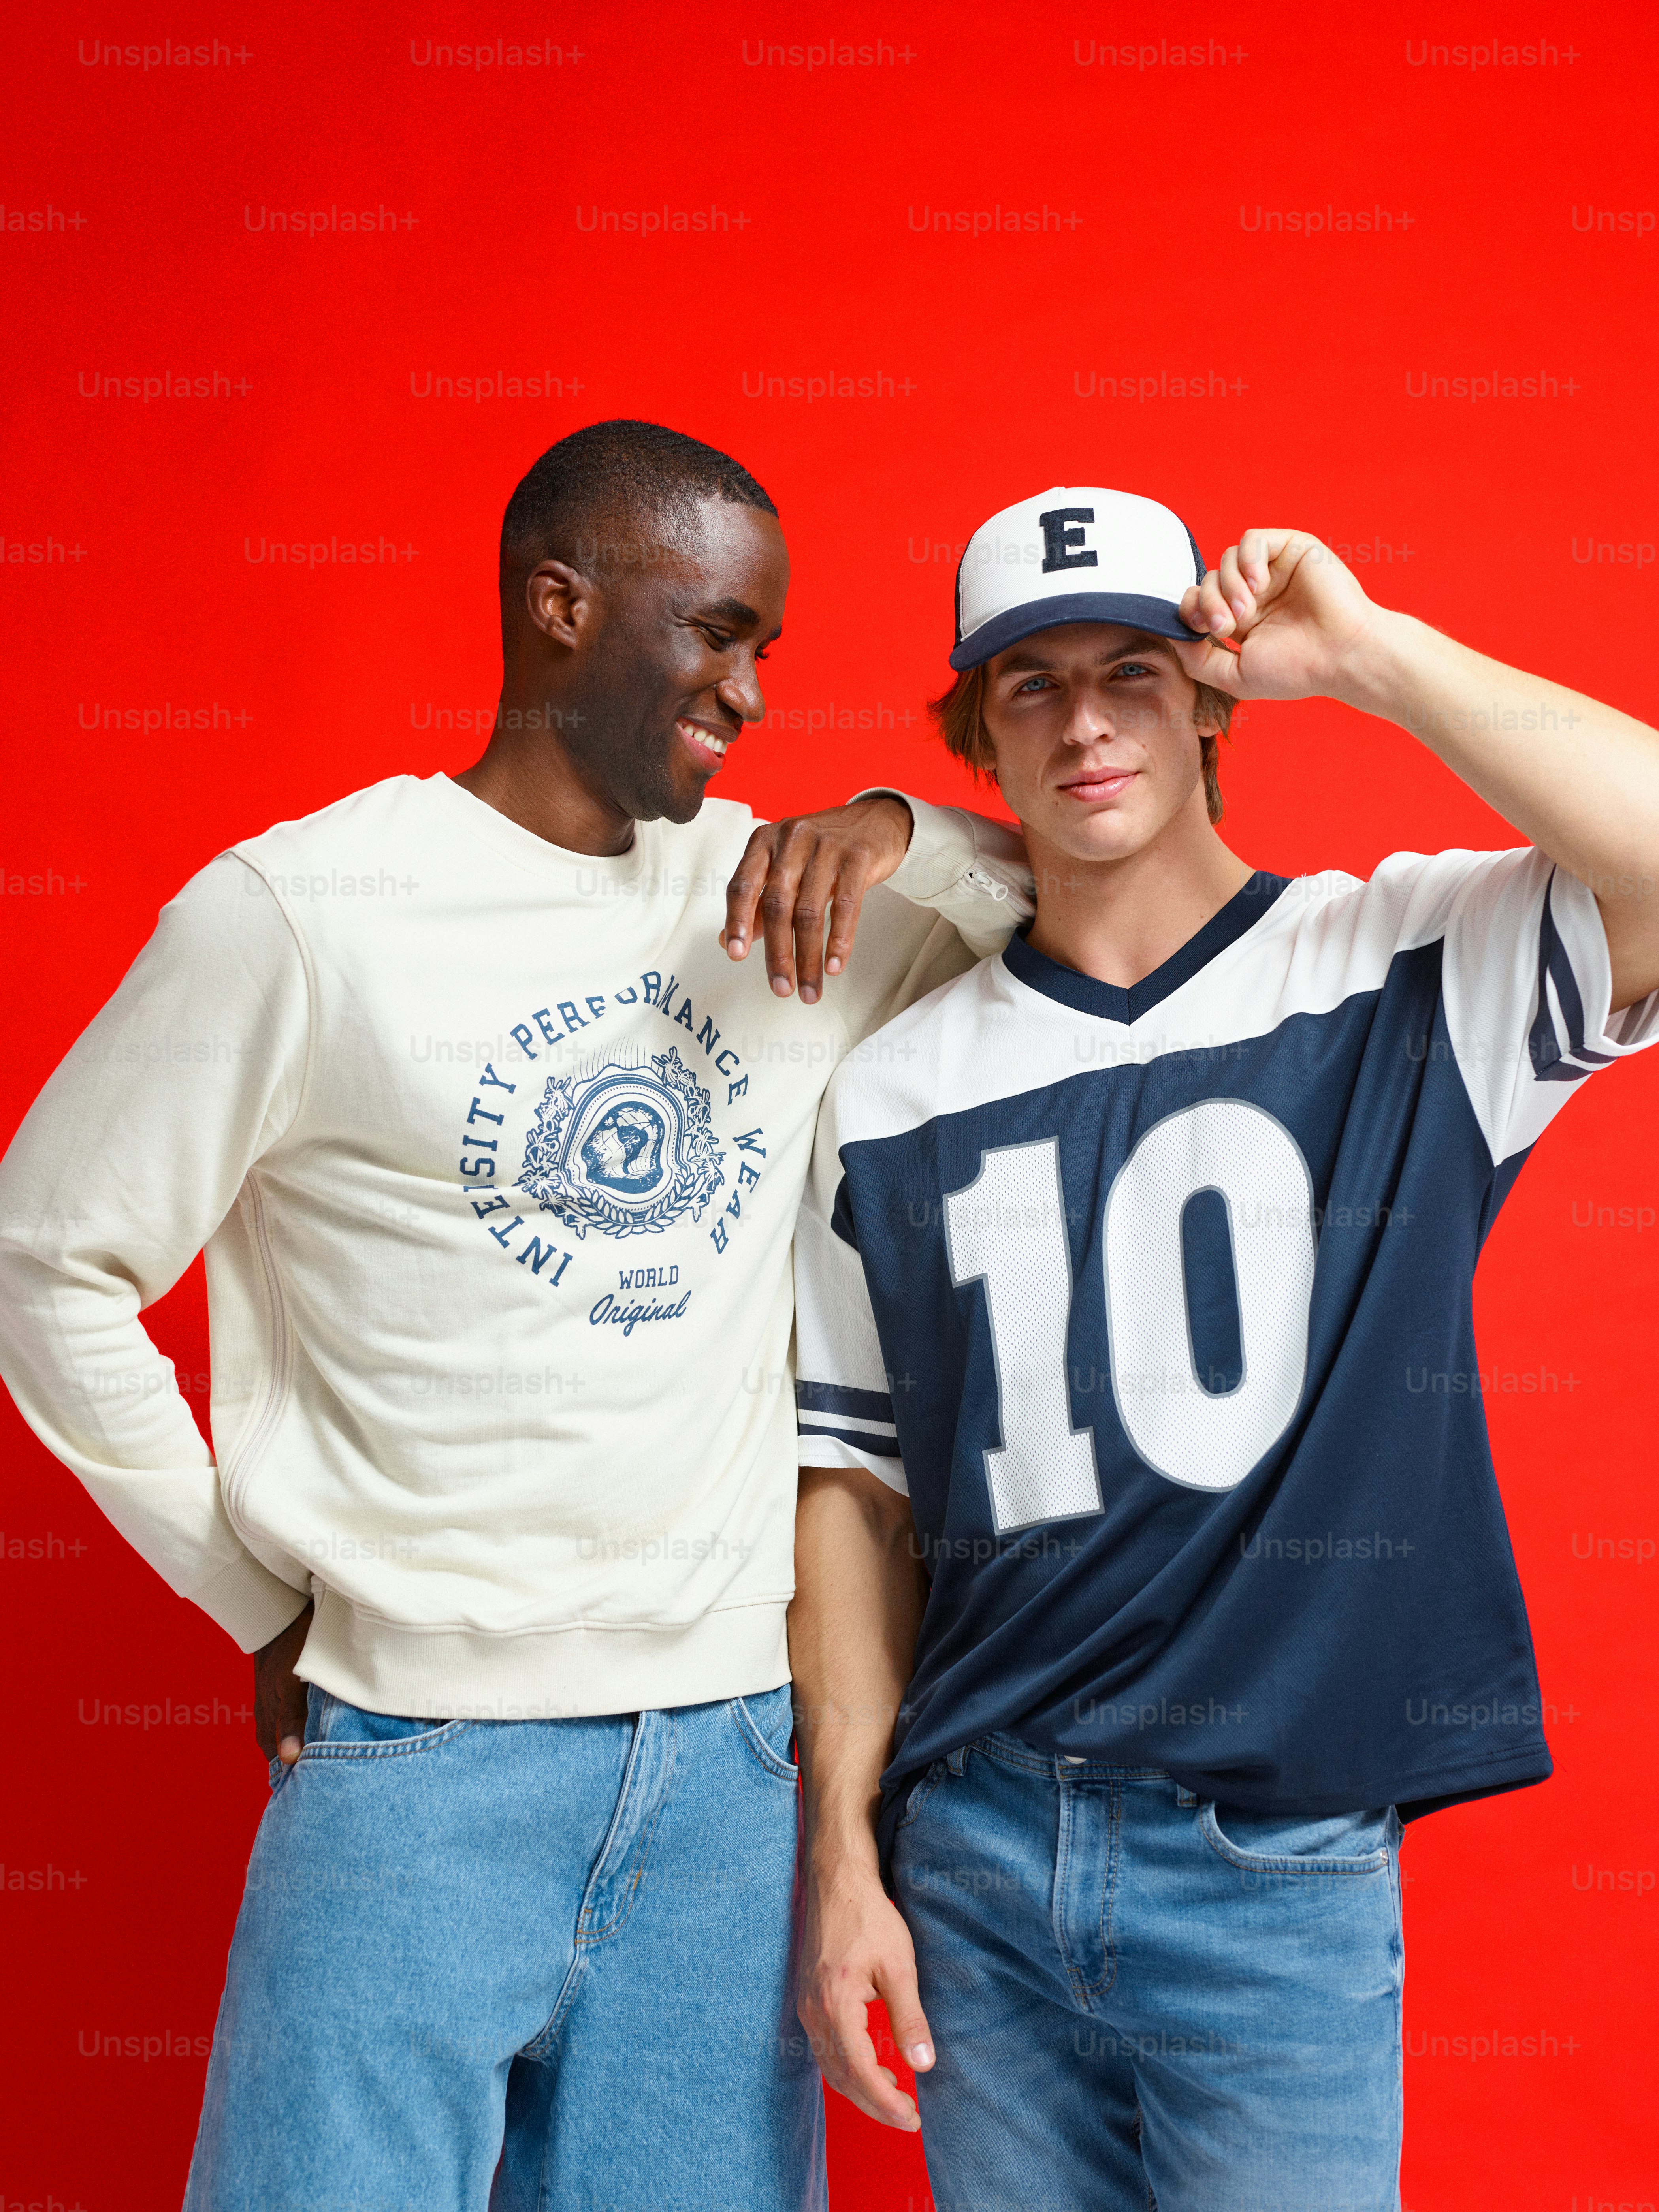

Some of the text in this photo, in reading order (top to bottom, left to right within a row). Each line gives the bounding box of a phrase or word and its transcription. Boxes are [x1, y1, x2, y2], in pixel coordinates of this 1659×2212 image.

[1039, 508, 1098, 574] E
[710, 1128, 766, 1255] WEAR
[619, 1265, 679, 1290] WORLD
[589, 1290, 691, 1337] Original
[942, 1097, 1319, 1536] 10
